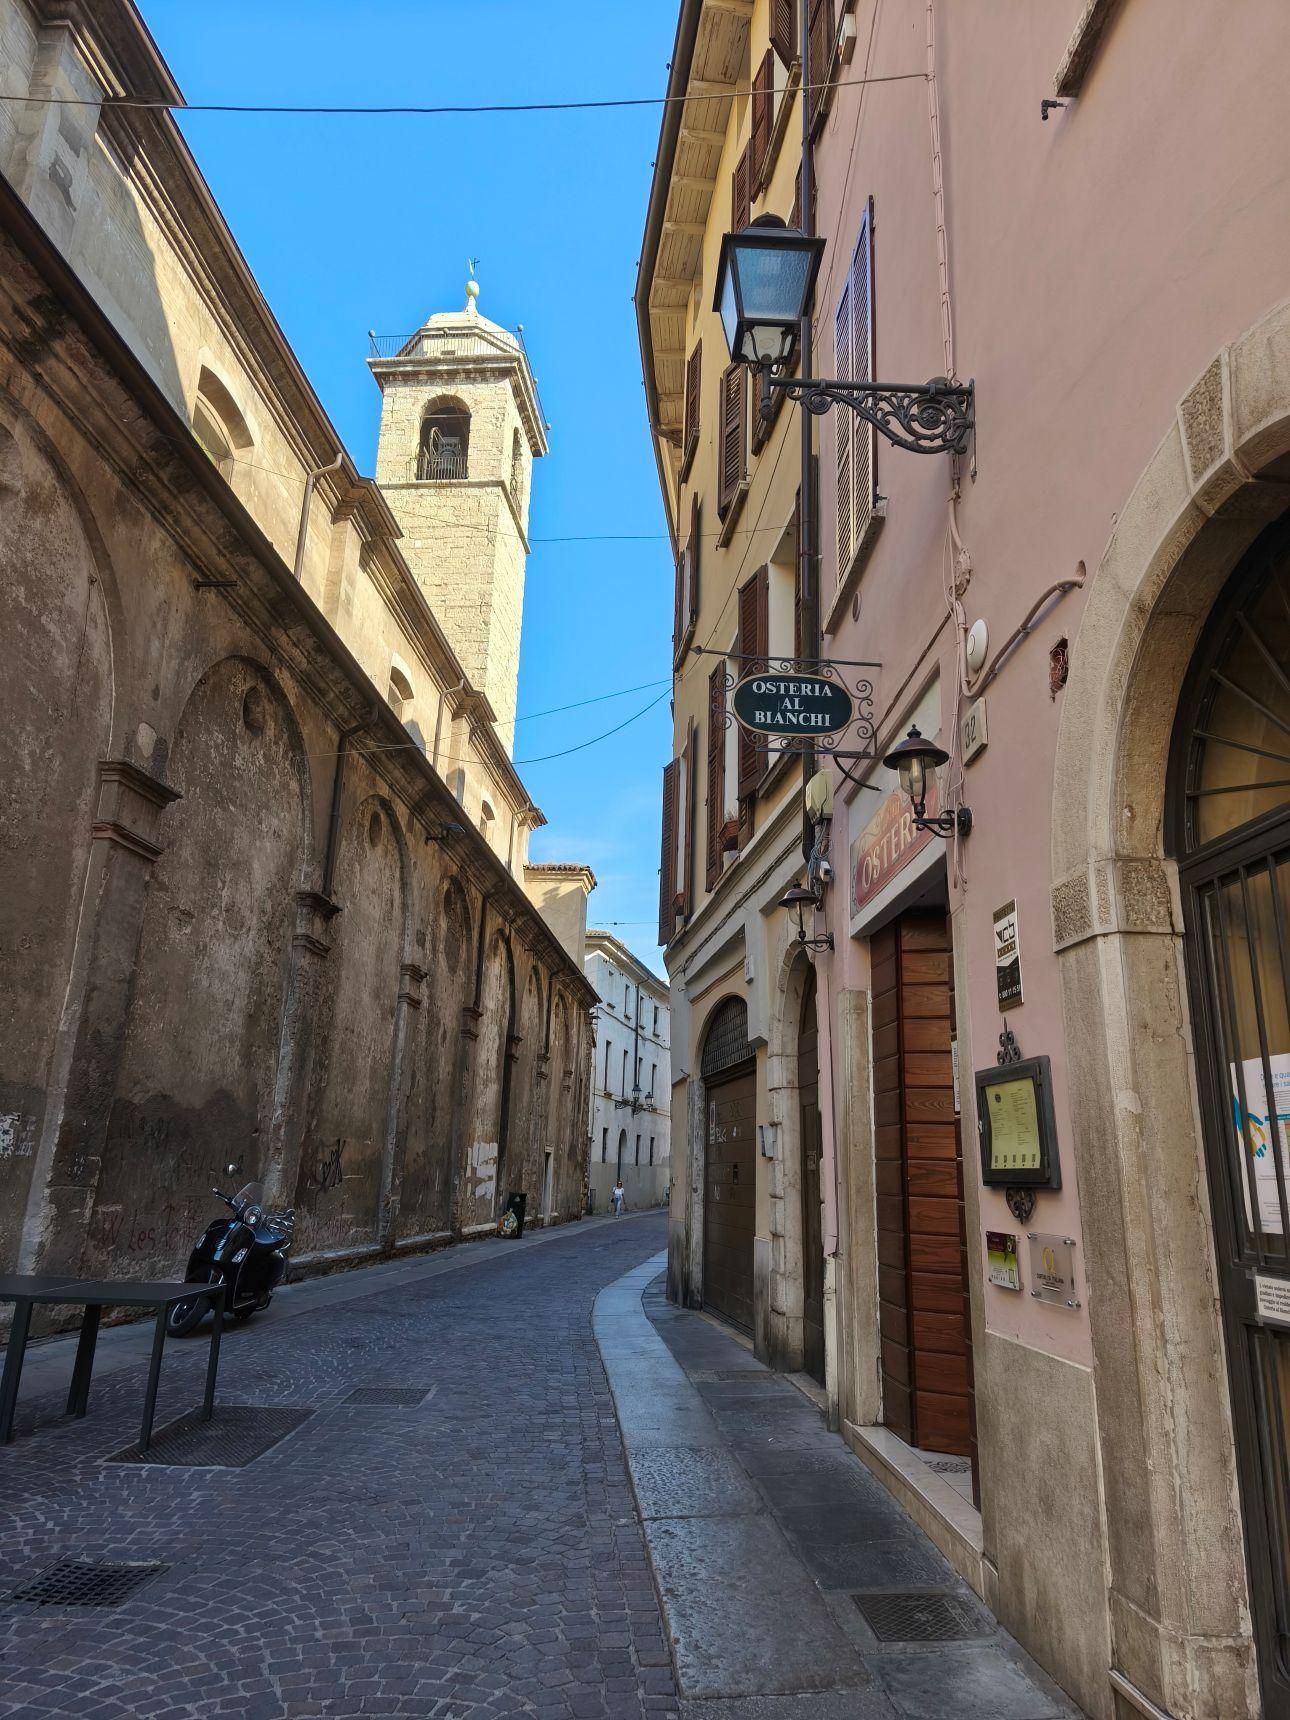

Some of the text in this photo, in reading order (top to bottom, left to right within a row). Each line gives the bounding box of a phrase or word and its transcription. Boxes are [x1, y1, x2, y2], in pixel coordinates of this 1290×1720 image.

[752, 681, 833, 697] OSTERIA
[781, 697, 804, 710] AL
[753, 710, 832, 727] BIANCHI
[964, 715, 977, 750] 32
[862, 803, 929, 891] OSTERI
